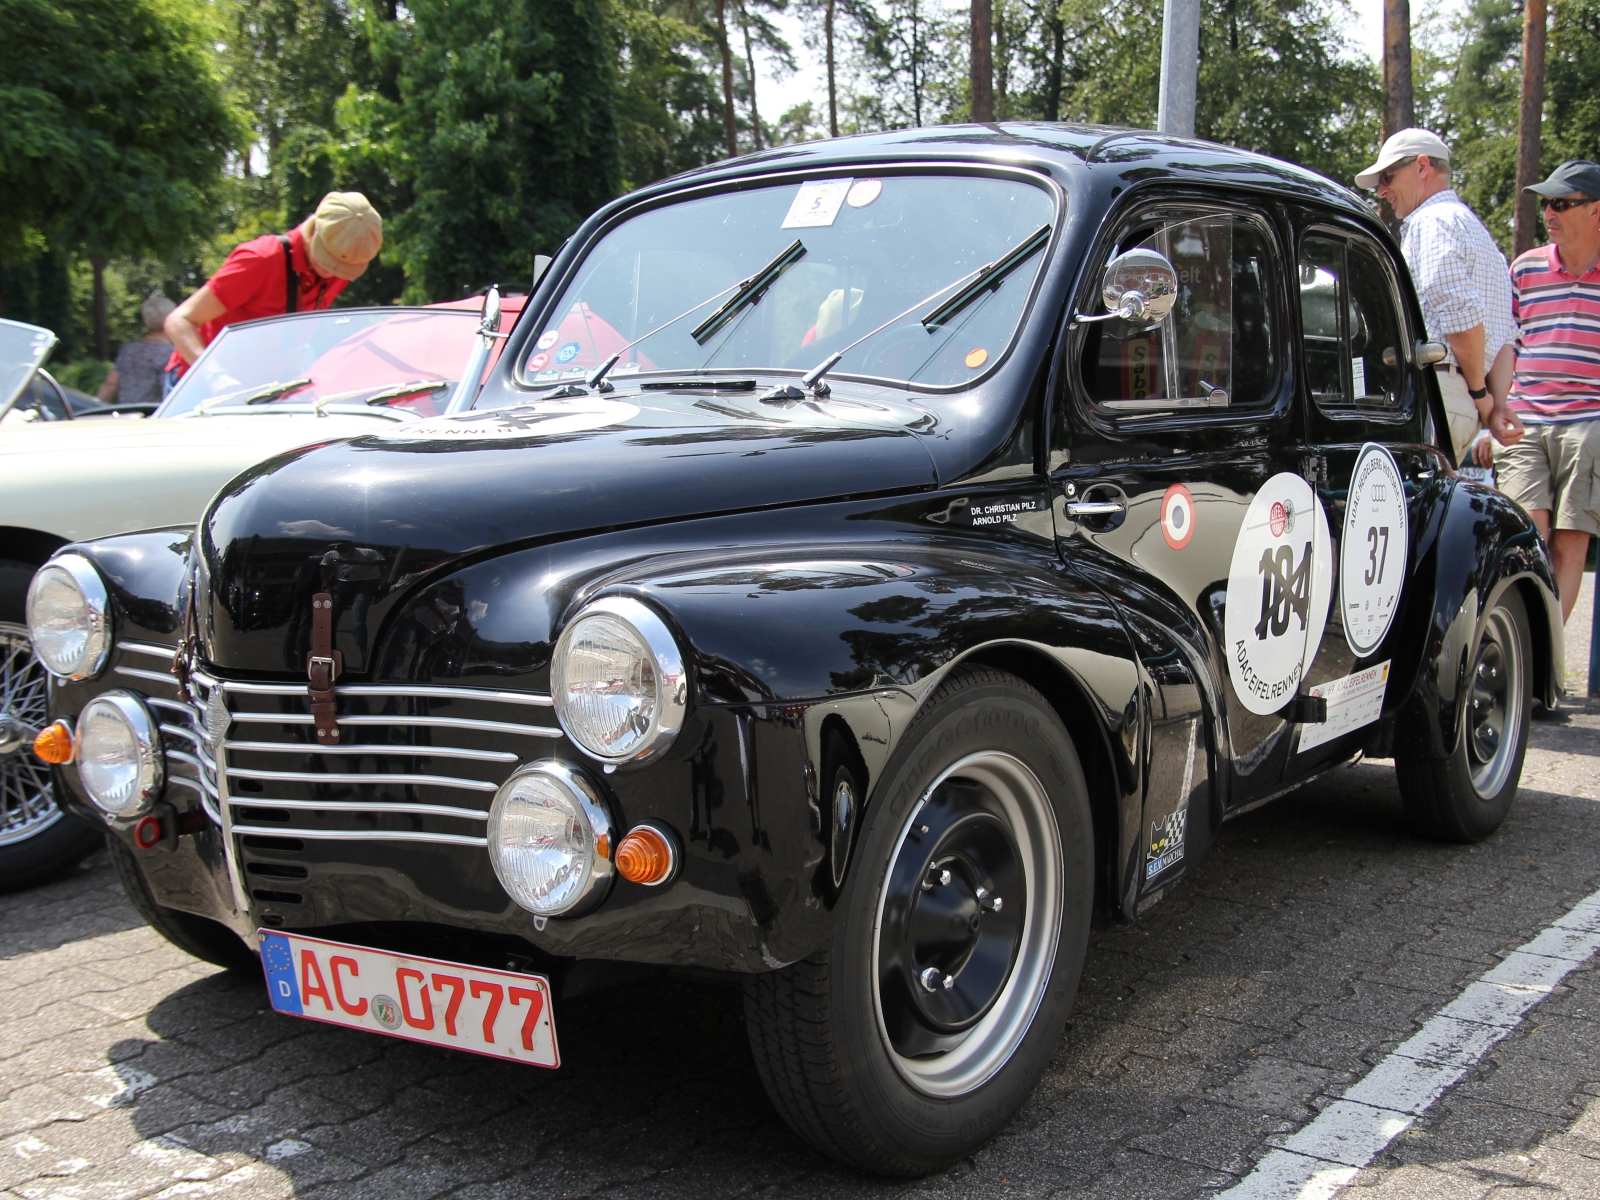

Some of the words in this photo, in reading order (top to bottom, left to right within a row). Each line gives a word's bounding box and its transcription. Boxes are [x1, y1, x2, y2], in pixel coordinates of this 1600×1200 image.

[811, 196, 823, 210] 5
[1350, 491, 1361, 529] ADAC
[1357, 458, 1383, 493] HEIDELBERG
[970, 507, 983, 516] DR.
[984, 503, 1020, 514] CHRISTIAN
[1021, 501, 1036, 510] PILZ
[972, 516, 1001, 526] ARNOLD
[1002, 513, 1017, 523] PILZ
[1365, 526, 1389, 587] 37
[1236, 639, 1253, 682] ADAC
[1247, 657, 1304, 700] EIFELRENNEN
[1148, 857, 1163, 876] S.E.V.
[278, 980, 291, 998] D
[301, 949, 368, 1016] AC
[396, 967, 544, 1051] 0777
